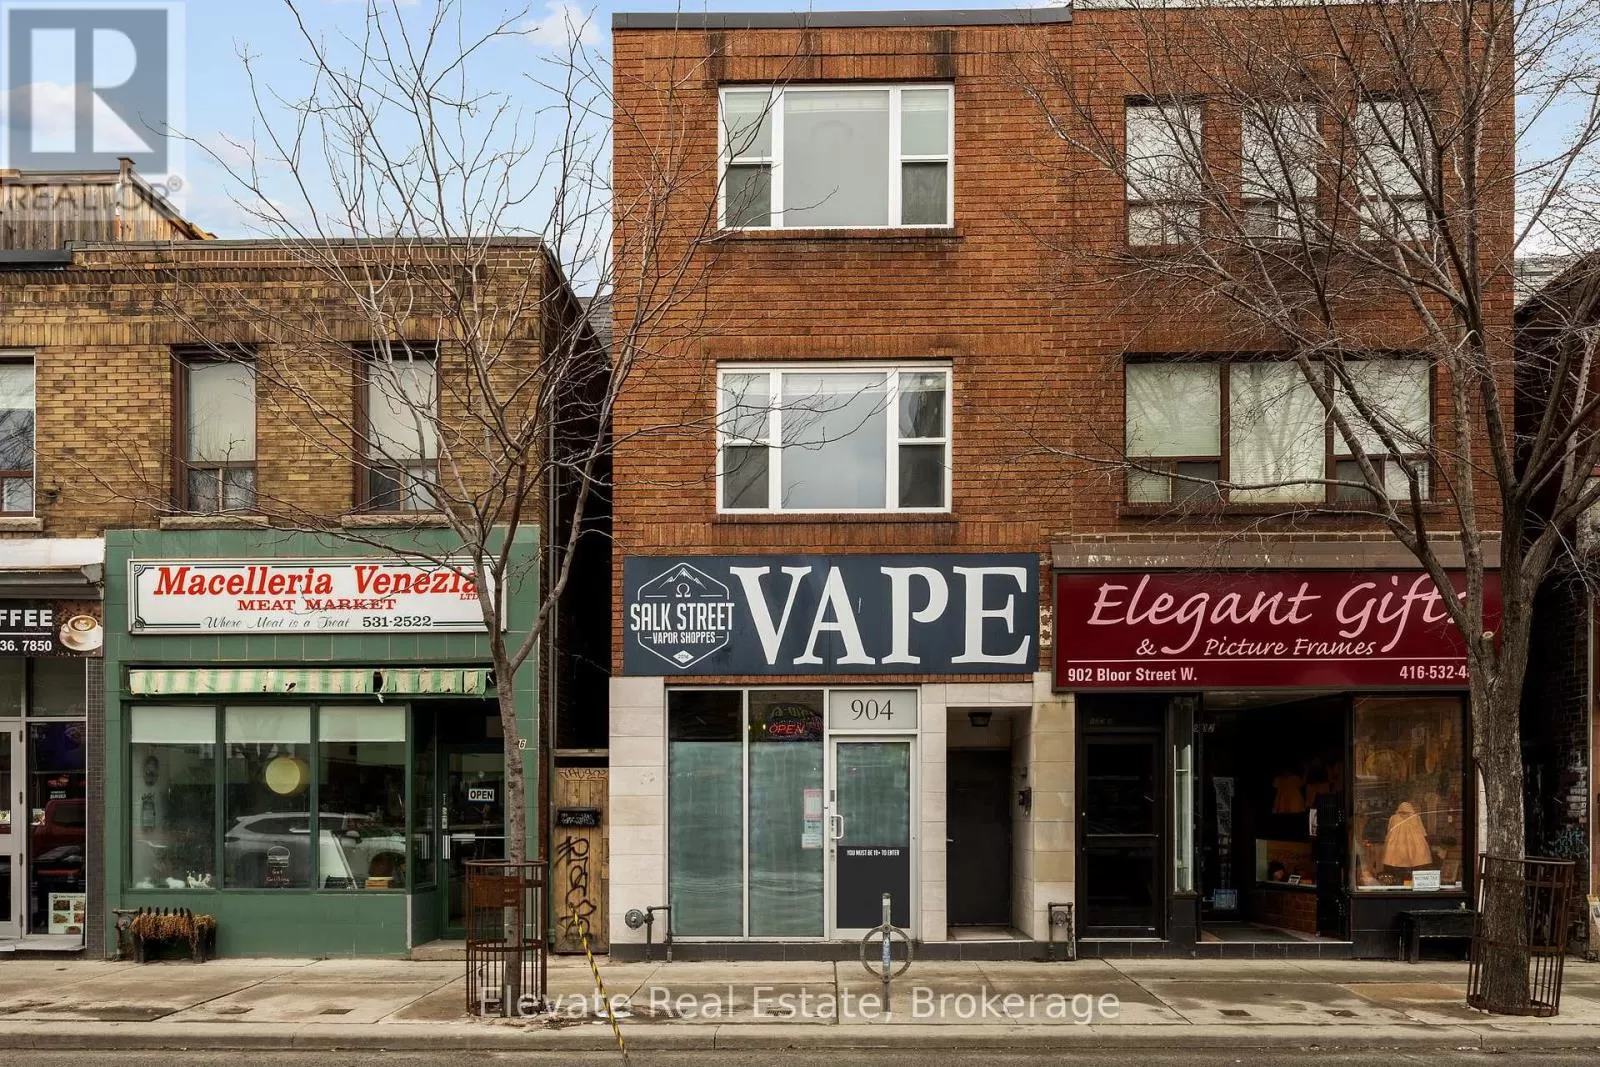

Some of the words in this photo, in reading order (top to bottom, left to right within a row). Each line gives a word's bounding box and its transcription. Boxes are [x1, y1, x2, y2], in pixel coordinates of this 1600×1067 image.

[153, 566, 333, 596] Macelleria
[354, 565, 479, 595] Venezia
[237, 600, 296, 611] MEAT
[304, 599, 397, 610] MARKET
[630, 603, 672, 632] SALK
[676, 602, 736, 631] STREET
[730, 566, 1031, 665] VAPE
[1087, 574, 1322, 655] Elegant
[202, 616, 242, 629] Where
[248, 616, 284, 629] Meat
[289, 617, 299, 628] is
[303, 620, 311, 628] a
[318, 616, 350, 629] Treat
[362, 616, 432, 628] 531-2522
[652, 632, 679, 645] VAPOR
[680, 631, 717, 645] SHOPPES
[22, 640, 53, 652] 7850
[1136, 638, 1158, 656] &
[1203, 635, 1289, 657] Picture
[1292, 638, 1377, 656] Frames
[1067, 667, 1093, 682] 902
[1097, 667, 1132, 682] Bloor
[1135, 667, 1177, 682] Street
[1180, 666, 1198, 681] W.
[1399, 665, 1470, 680] 416-532-4
[851, 699, 894, 721] 904
[768, 723, 806, 735] OPEN
[470, 790, 494, 800] OPEN
[856, 849, 867, 857] MUST
[867, 849, 873, 857] BE
[881, 849, 888, 857] TO
